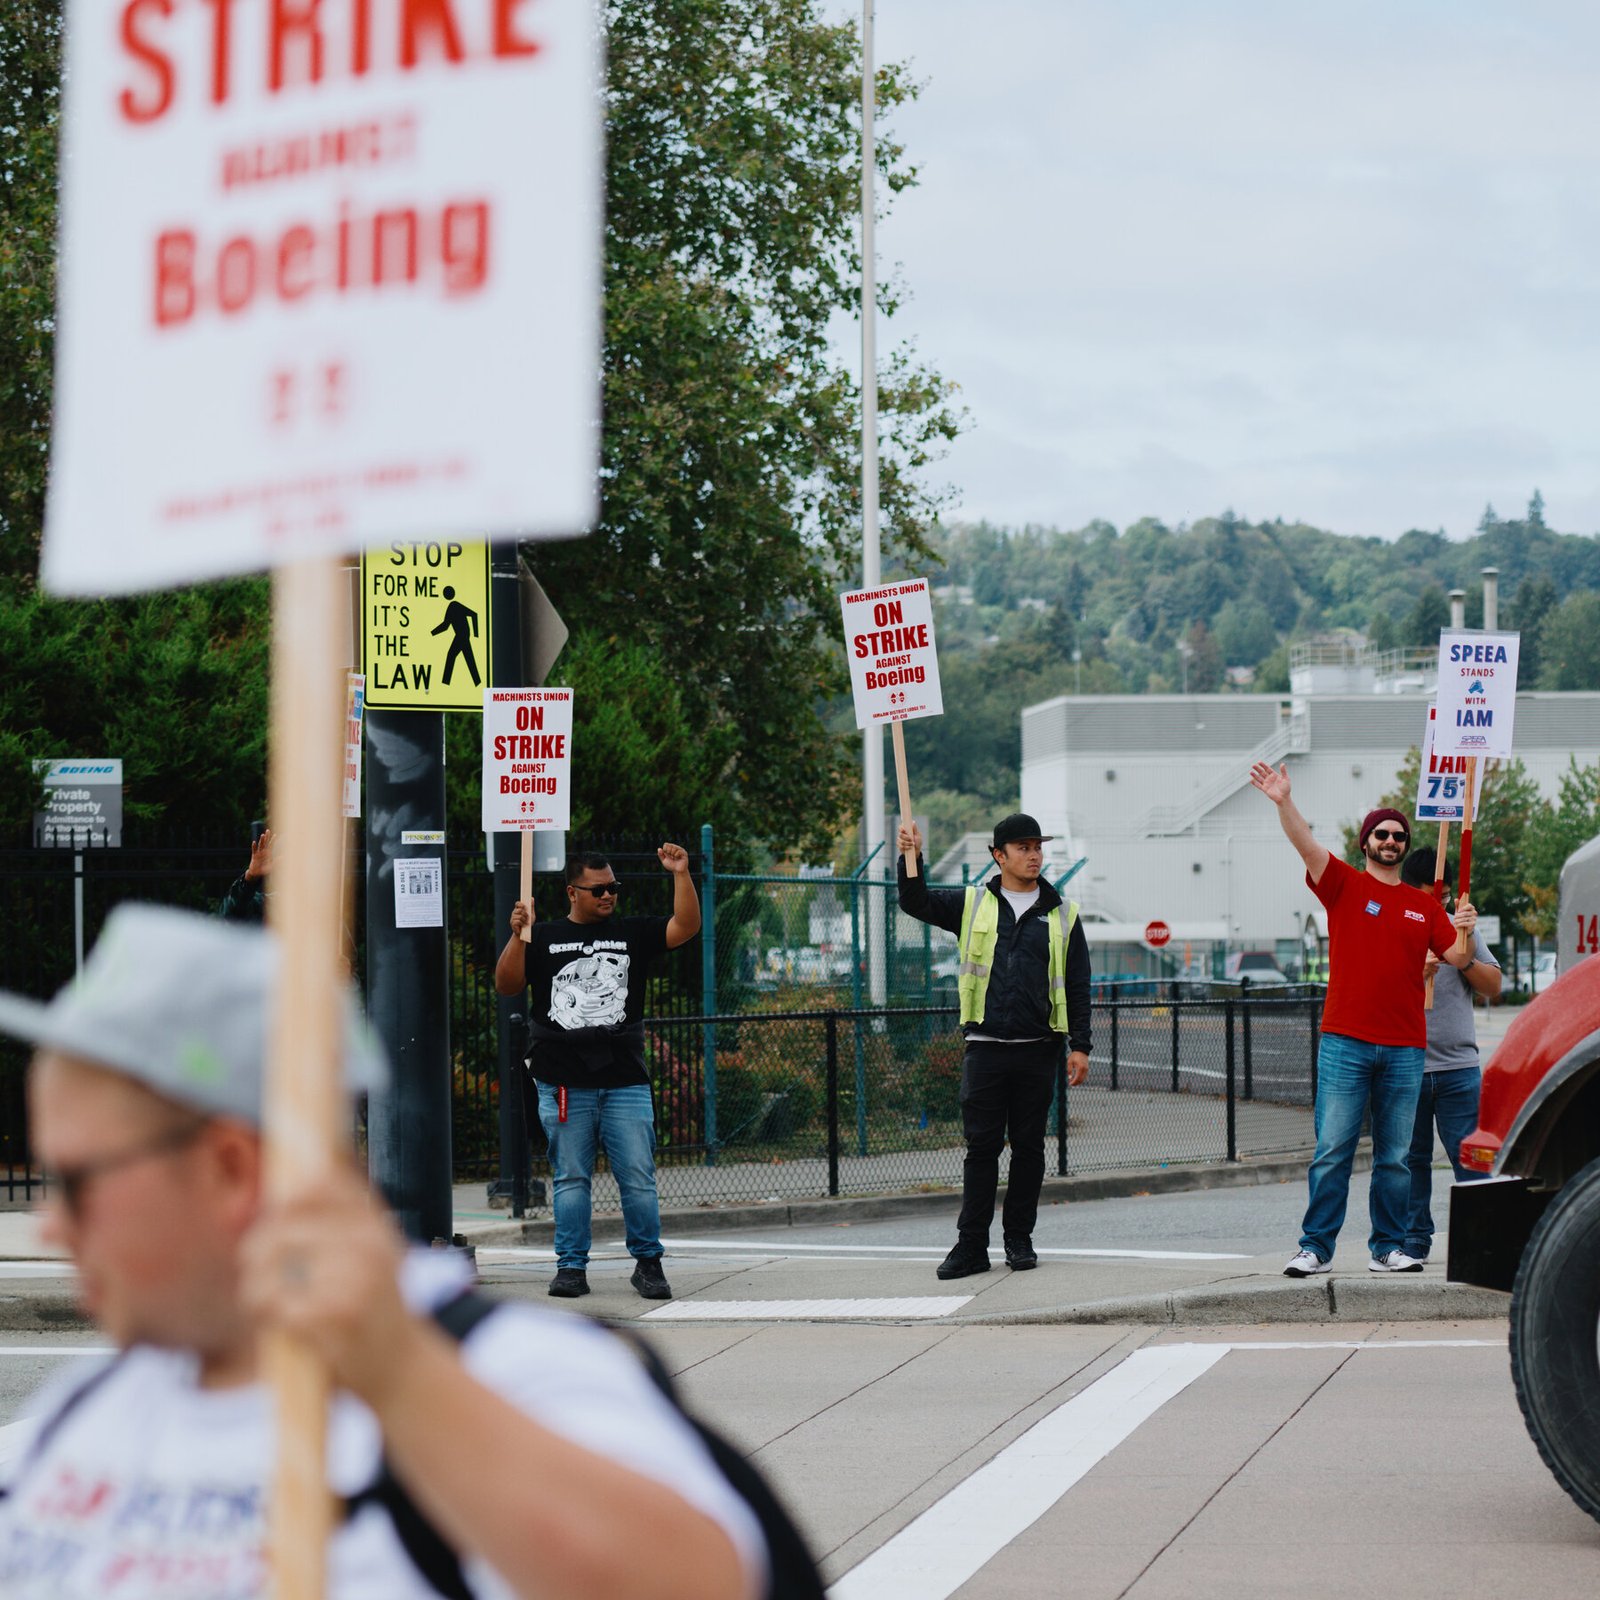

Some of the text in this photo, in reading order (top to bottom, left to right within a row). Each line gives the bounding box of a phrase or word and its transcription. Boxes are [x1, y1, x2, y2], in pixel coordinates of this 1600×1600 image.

[152, 198, 490, 328] Boeing
[390, 541, 463, 568] STOP
[374, 574, 439, 597] FOR ME
[846, 582, 926, 604] MACHINISTS UNION
[374, 605, 410, 628] IT'S
[873, 600, 904, 627] ON
[374, 634, 409, 656] THE
[853, 624, 929, 659] STRIKE
[875, 654, 911, 669] AGAINST
[1450, 644, 1507, 663] SPEEA
[374, 663, 432, 690] LAW
[865, 666, 926, 690] Boeing
[1460, 667, 1495, 677] STANDS
[492, 692, 570, 702] MACHINISTS UNION
[1464, 697, 1486, 705] WITH
[516, 706, 544, 731] ON
[1456, 709, 1493, 728] IAM
[494, 735, 566, 760] STRIKE
[59, 766, 114, 774] BOEING
[511, 763, 546, 774] AGAINST
[500, 775, 557, 795] Boeing
[90, 833, 112, 842] Ony
[1147, 928, 1170, 939] STOP
[1577, 914, 1598, 954] 14
